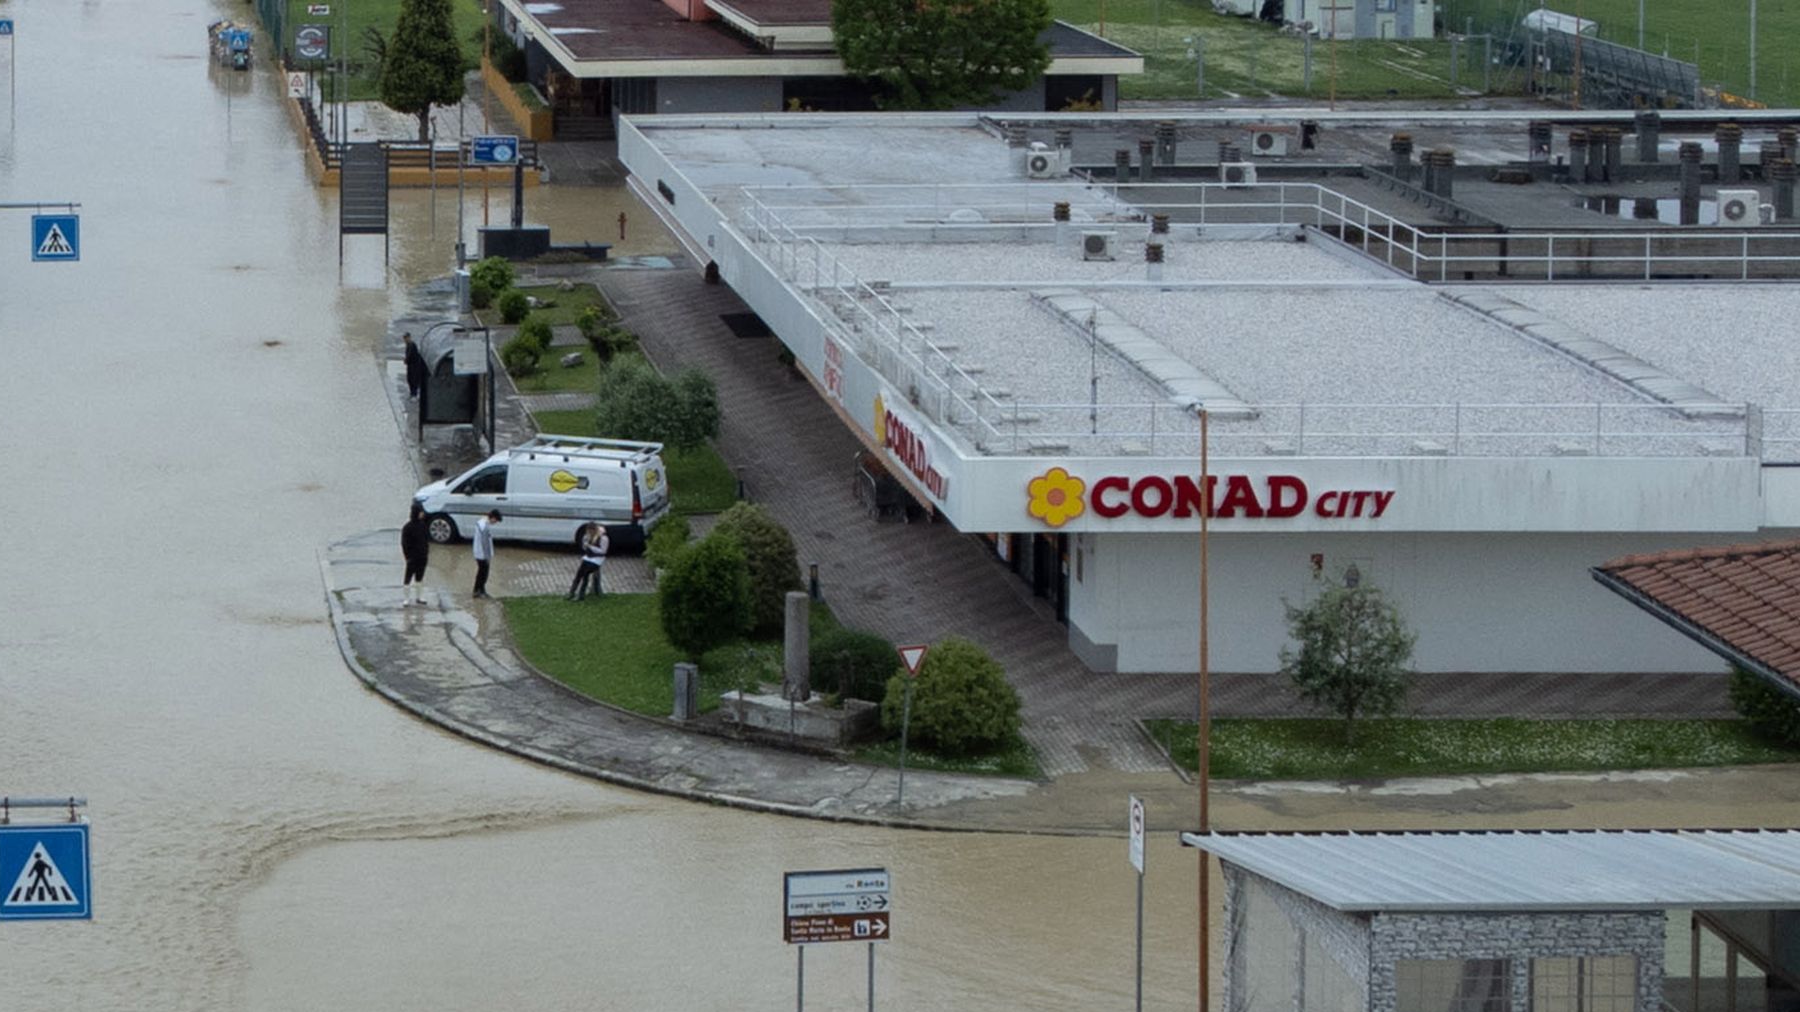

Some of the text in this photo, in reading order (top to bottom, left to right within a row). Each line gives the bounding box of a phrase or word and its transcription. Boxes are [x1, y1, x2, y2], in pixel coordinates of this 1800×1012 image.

[885, 409, 926, 483] CONAD
[1090, 475, 1396, 519] CONAD CITY
